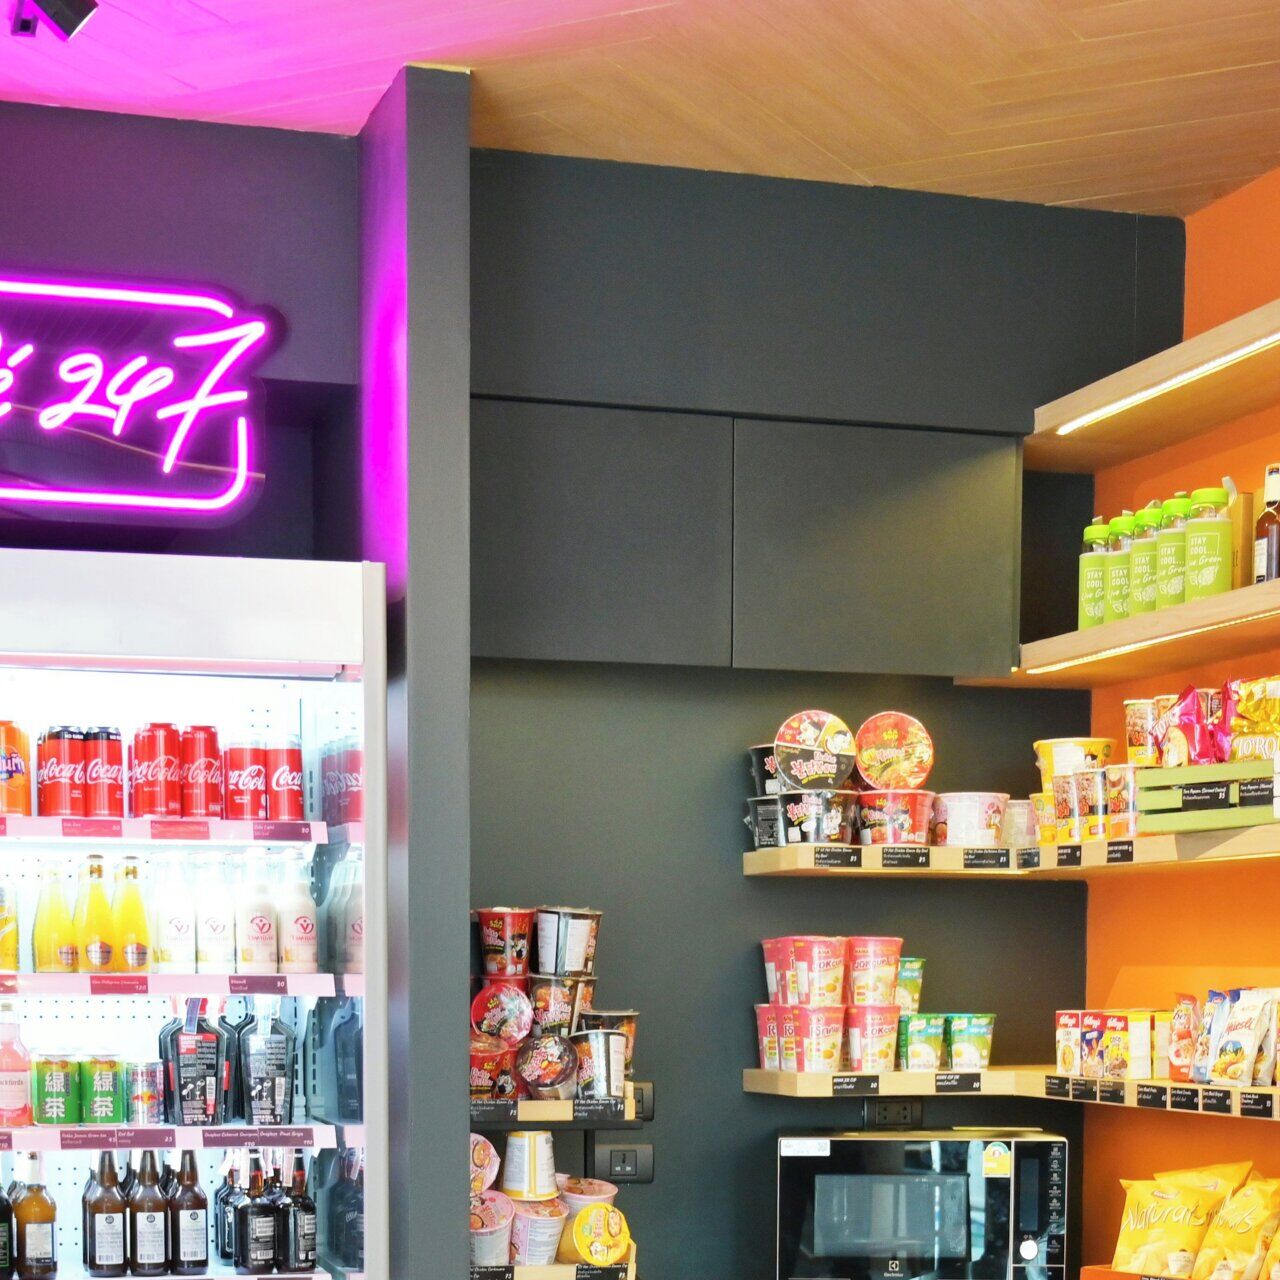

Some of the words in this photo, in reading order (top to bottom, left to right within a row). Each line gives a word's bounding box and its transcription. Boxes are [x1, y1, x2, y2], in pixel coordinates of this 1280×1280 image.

[1190, 537, 1206, 545] STAY
[1161, 547, 1175, 555] STAY
[1135, 556, 1150, 564] STAY
[1087, 571, 1102, 579] STAY
[1112, 569, 1128, 577] STAY
